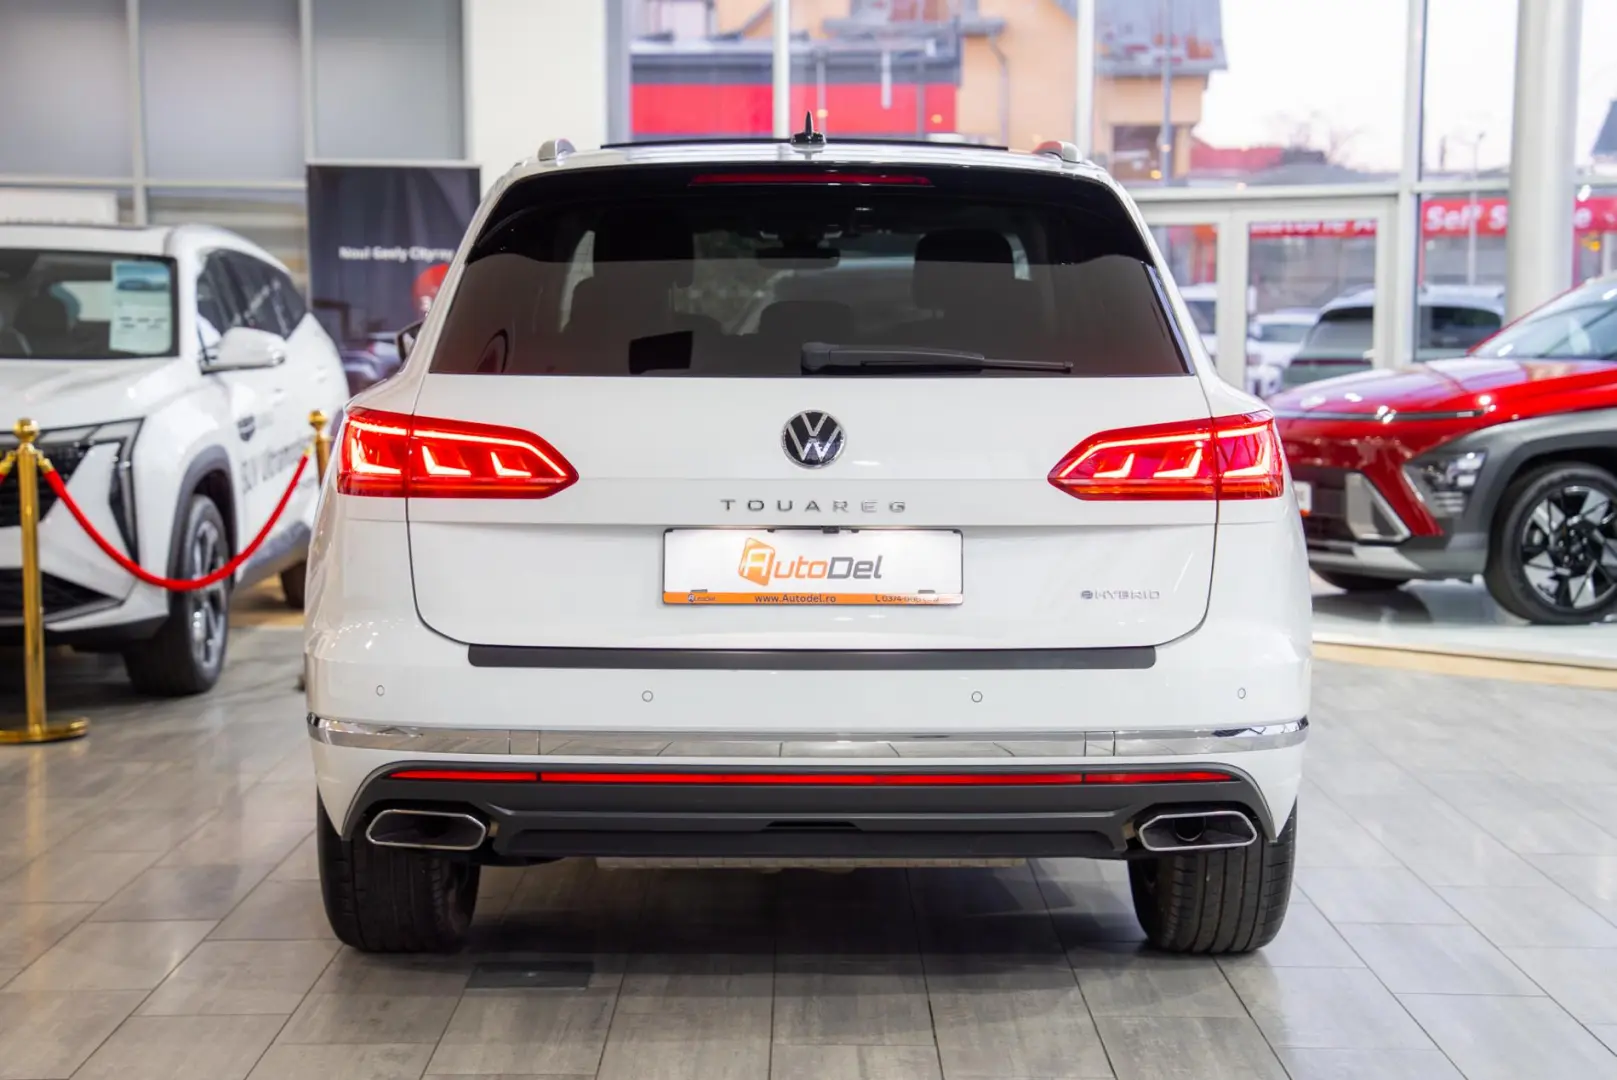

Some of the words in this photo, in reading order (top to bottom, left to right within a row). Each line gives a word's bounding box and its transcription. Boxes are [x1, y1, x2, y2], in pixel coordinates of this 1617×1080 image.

[720, 499, 907, 512] TOUAREG
[737, 537, 883, 586] AutoDel
[754, 594, 837, 603] www.Autodel.ro
